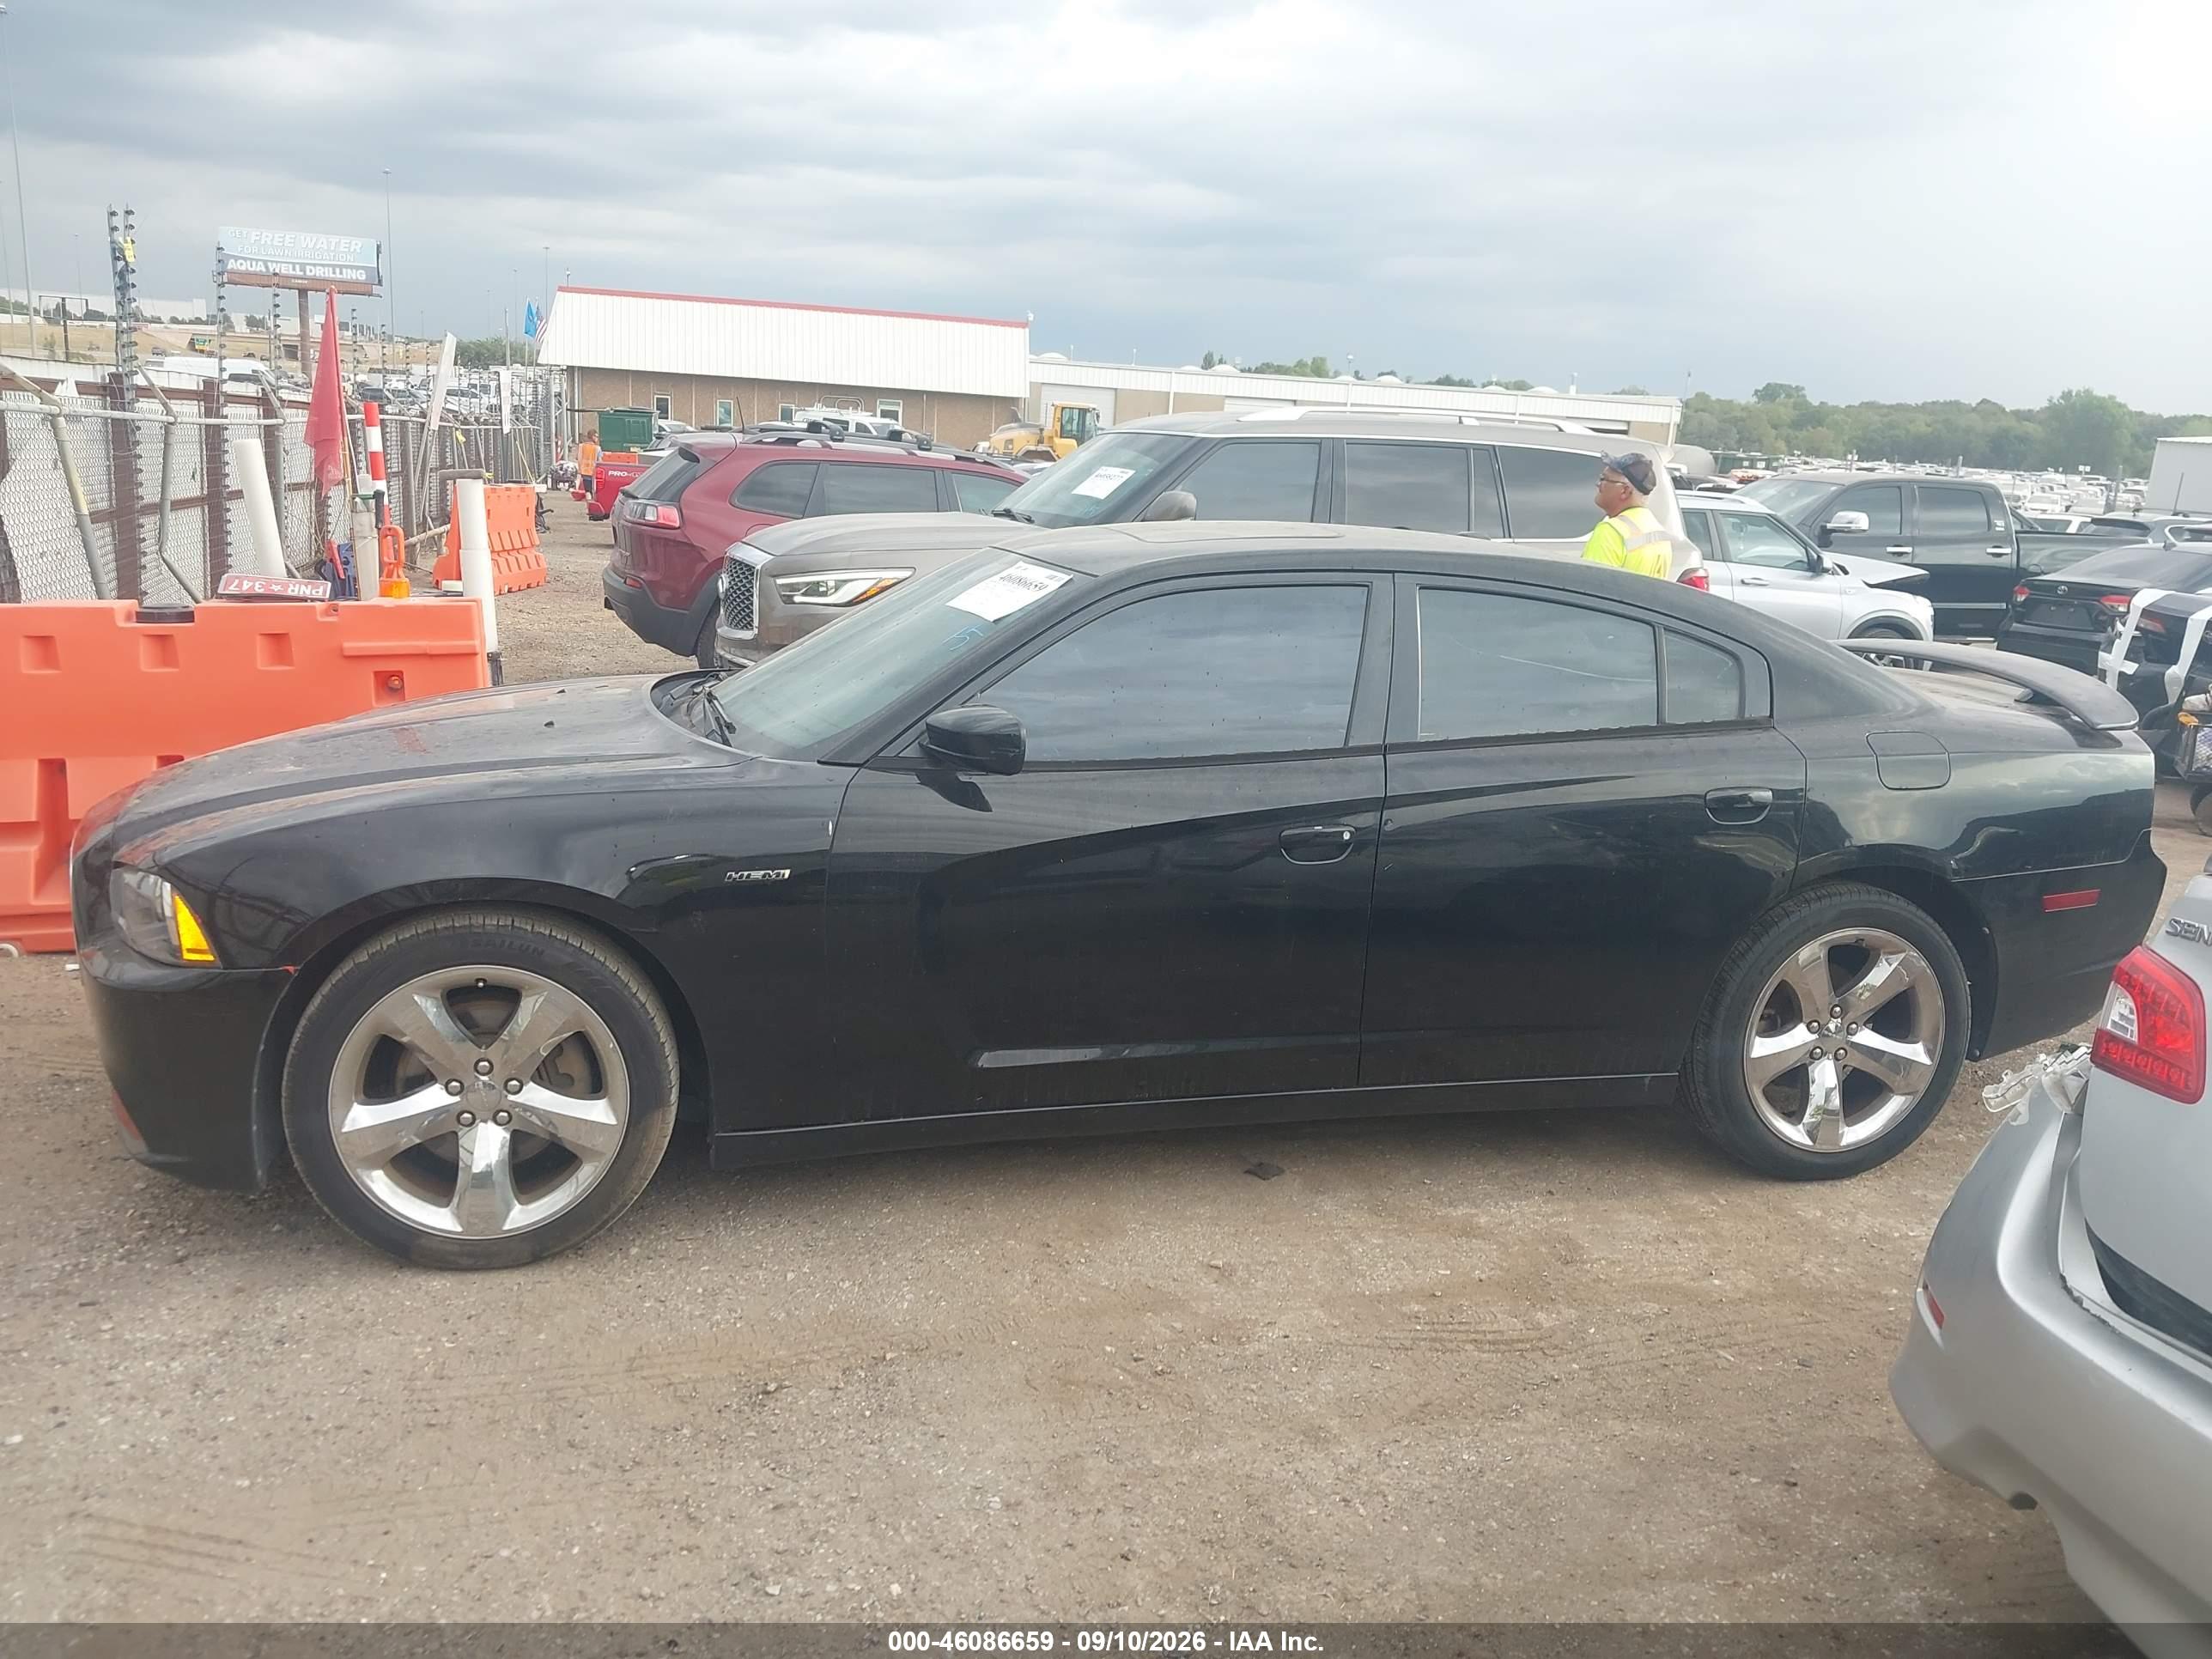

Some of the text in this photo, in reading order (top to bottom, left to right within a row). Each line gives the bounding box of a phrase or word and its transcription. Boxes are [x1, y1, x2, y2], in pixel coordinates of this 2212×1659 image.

[228, 229, 363, 253] GET FREE WATER
[239, 246, 355, 262] FOR LAWN IRRIGATION
[227, 258, 367, 281] AQUA WELL DRILLING
[228, 579, 324, 596] PNR 347
[725, 869, 791, 882] HEMI
[470, 937, 546, 957] SAILUN
